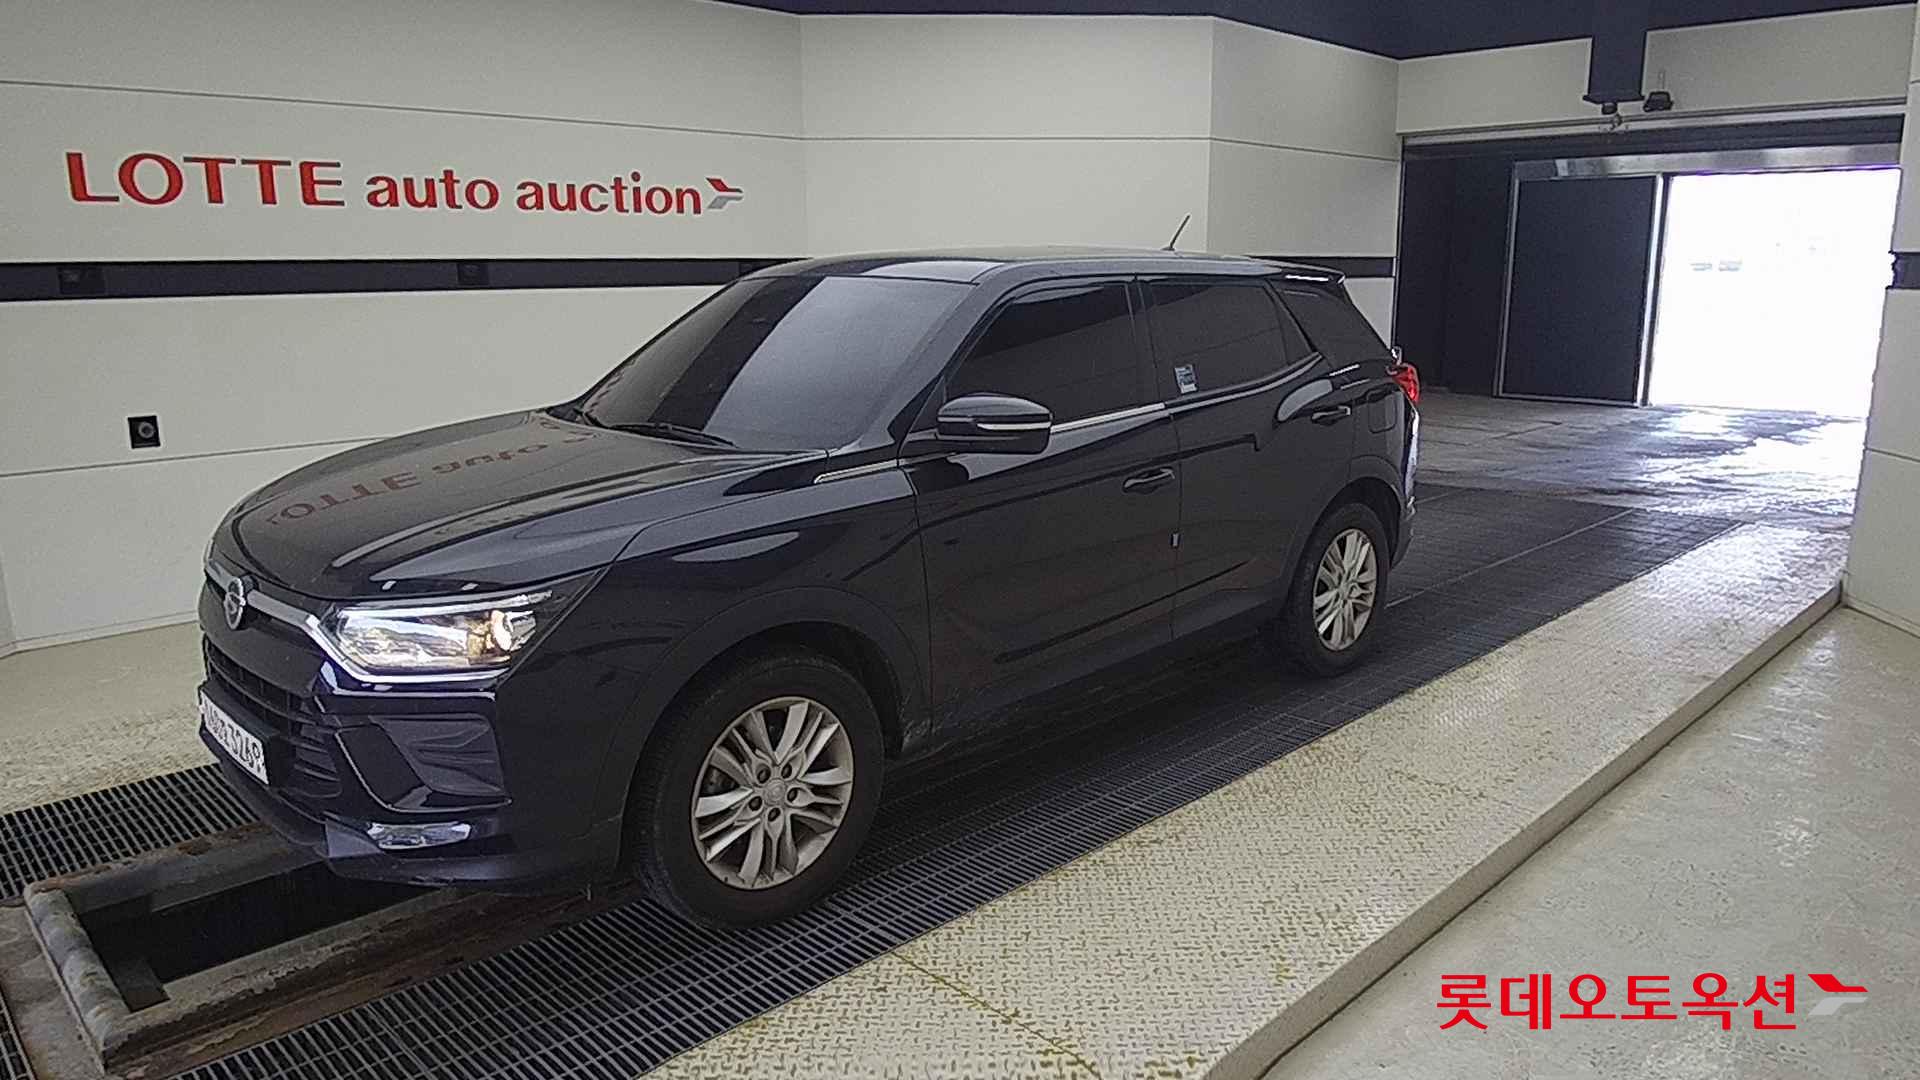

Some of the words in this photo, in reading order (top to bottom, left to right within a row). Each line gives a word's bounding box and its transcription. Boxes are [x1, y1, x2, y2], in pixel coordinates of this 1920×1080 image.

[66, 152, 345, 206] LOTTE
[366, 169, 500, 210] auto
[516, 171, 702, 215] auction
